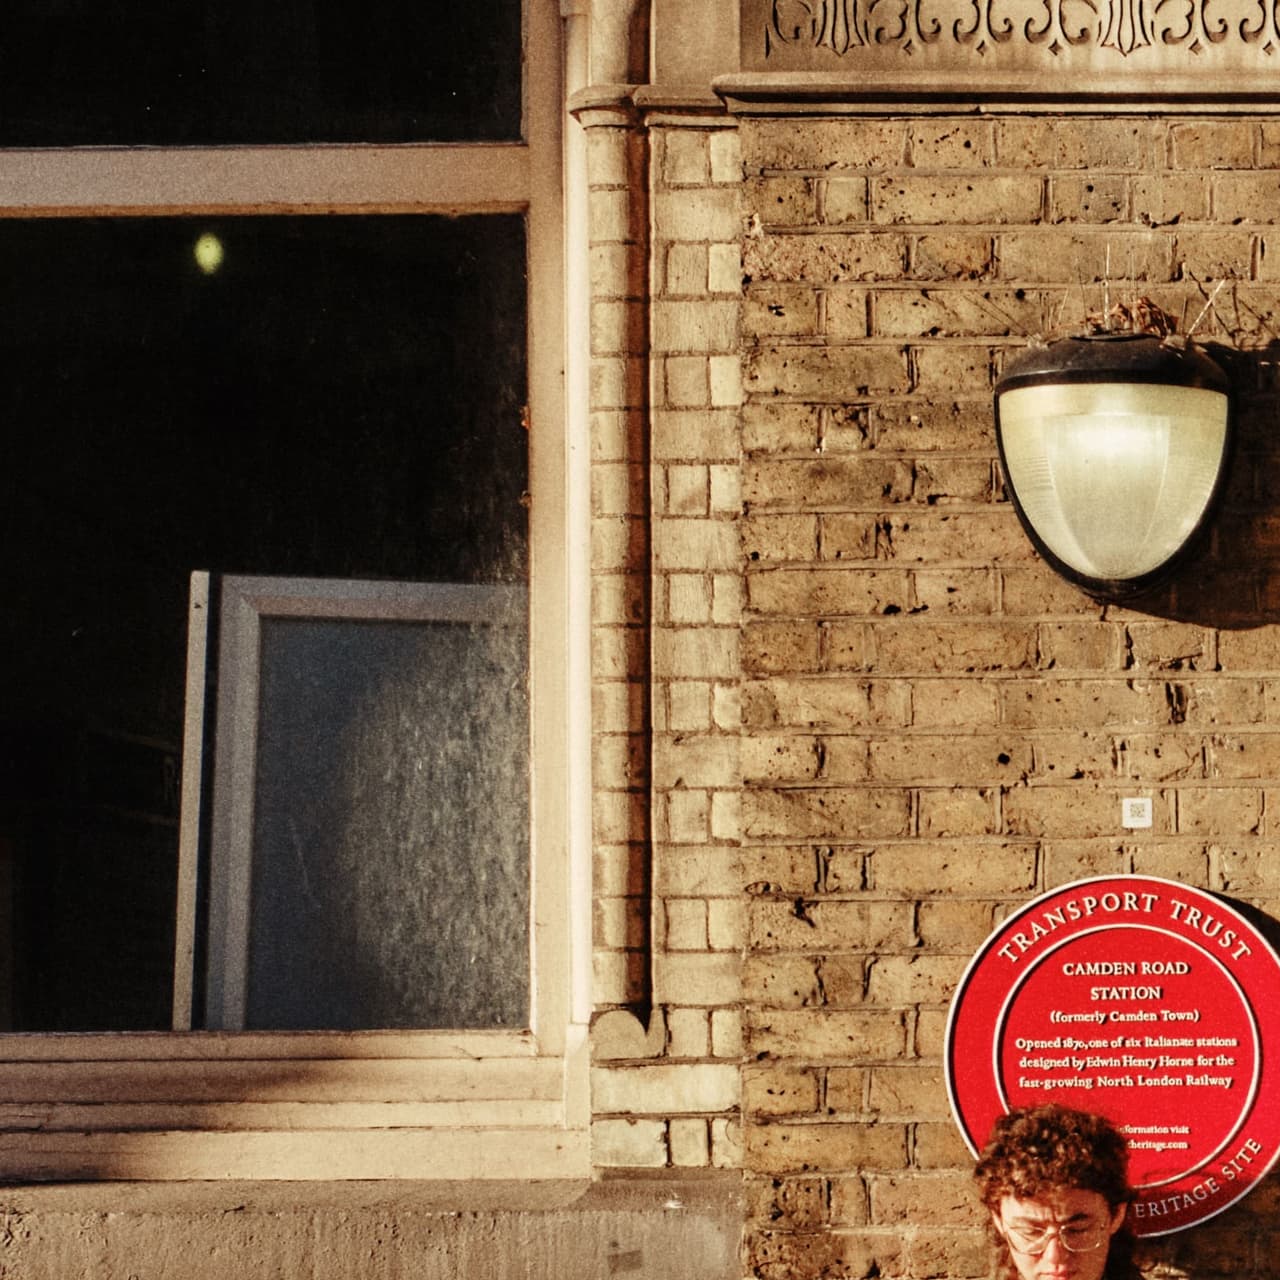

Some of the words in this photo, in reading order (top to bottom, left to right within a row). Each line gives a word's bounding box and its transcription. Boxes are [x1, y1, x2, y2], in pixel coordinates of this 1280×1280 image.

[998, 892, 1158, 963] TRANSPORT
[1170, 900, 1252, 961] TRUST
[1062, 961, 1135, 976] CAMDEN
[1141, 961, 1189, 975] ROAD
[1090, 986, 1161, 1001] STATION
[1050, 1010, 1106, 1024] (formerly
[1110, 1011, 1158, 1021] Camden
[1161, 1009, 1200, 1022] Town)
[1015, 1037, 1061, 1051] Opened
[1111, 1036, 1124, 1048] of
[1125, 1037, 1141, 1048] six
[1145, 1036, 1194, 1048] Italianate
[1197, 1036, 1237, 1048] stations
[1019, 1056, 1069, 1071] designed
[1072, 1056, 1086, 1071] by
[1087, 1056, 1120, 1068] Edwin
[1122, 1055, 1157, 1070] Henry
[1159, 1056, 1194, 1067] Horne
[1197, 1055, 1215, 1067] for
[1216, 1055, 1235, 1066] the
[1019, 1075, 1093, 1090] fast-growing
[1097, 1075, 1134, 1087] North
[1138, 1074, 1182, 1087] London
[1186, 1074, 1232, 1088] Railway
[1170, 1125, 1190, 1134] visit
[1127, 1139, 1188, 1152] heritage.com
[1135, 1177, 1220, 1218] ERITAGE
[1222, 1138, 1262, 1181] SITE
